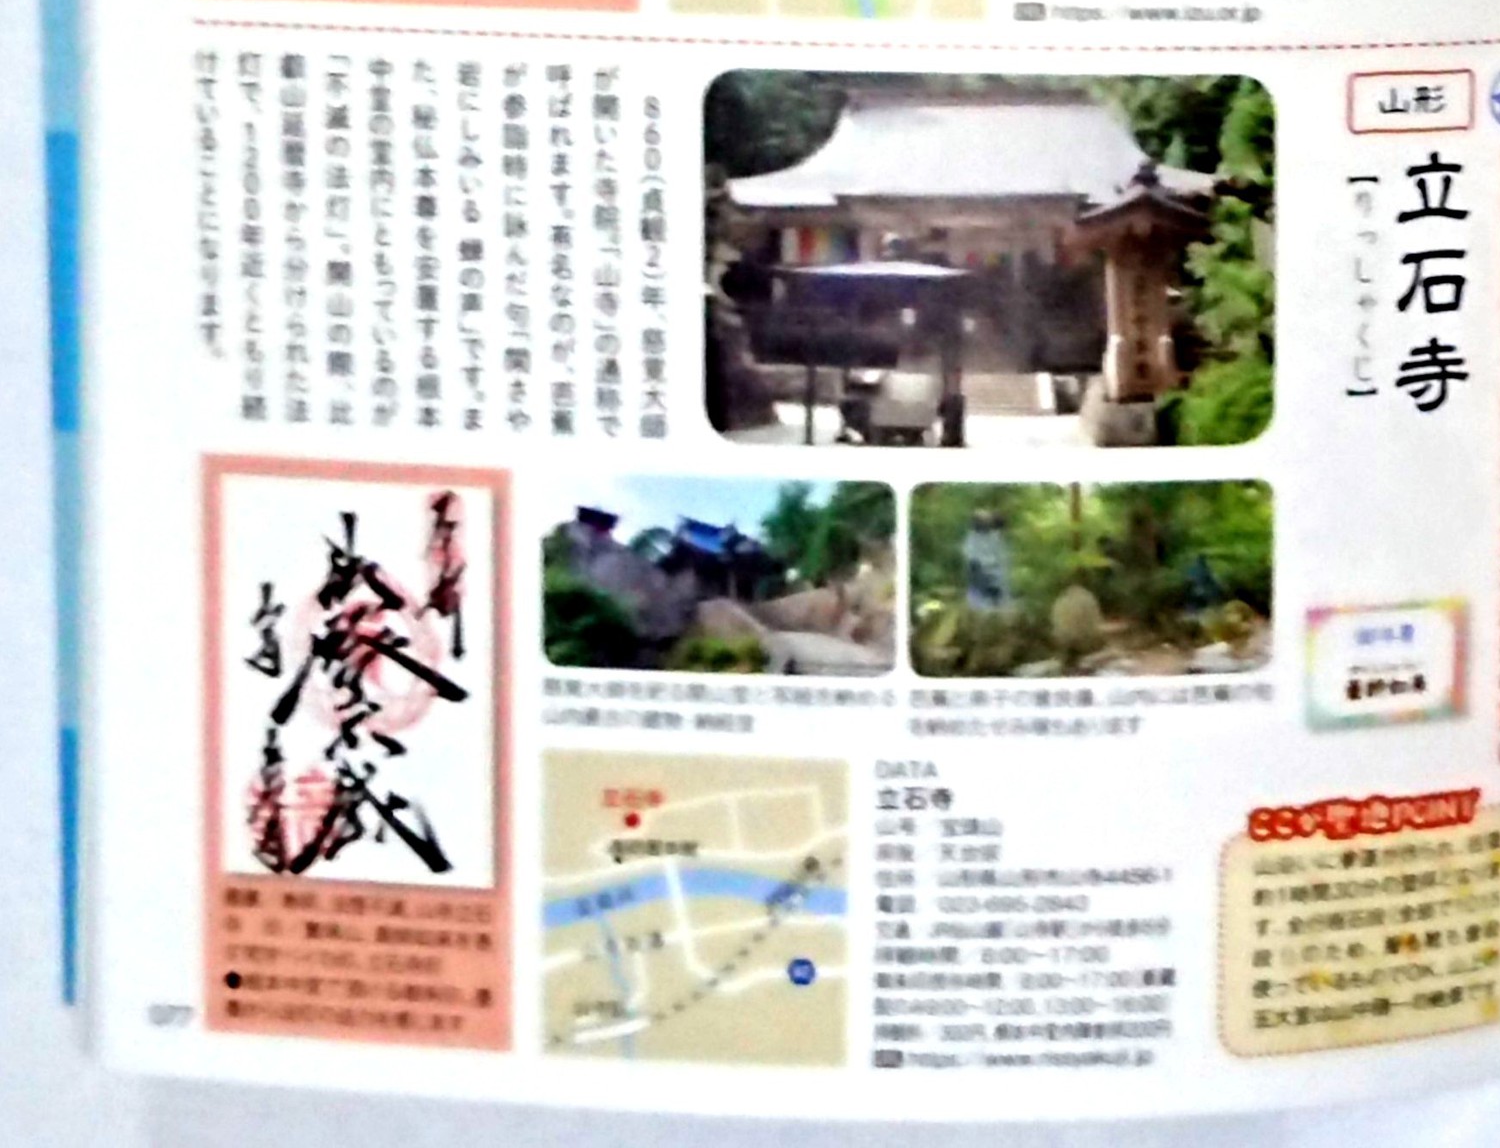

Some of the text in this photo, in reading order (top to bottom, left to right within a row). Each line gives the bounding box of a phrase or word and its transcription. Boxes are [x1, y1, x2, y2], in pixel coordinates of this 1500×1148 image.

[1378, 86, 1448, 116] 山形
[1396, 151, 1470, 414] 立石寺
[875, 785, 954, 812] 立石寺
